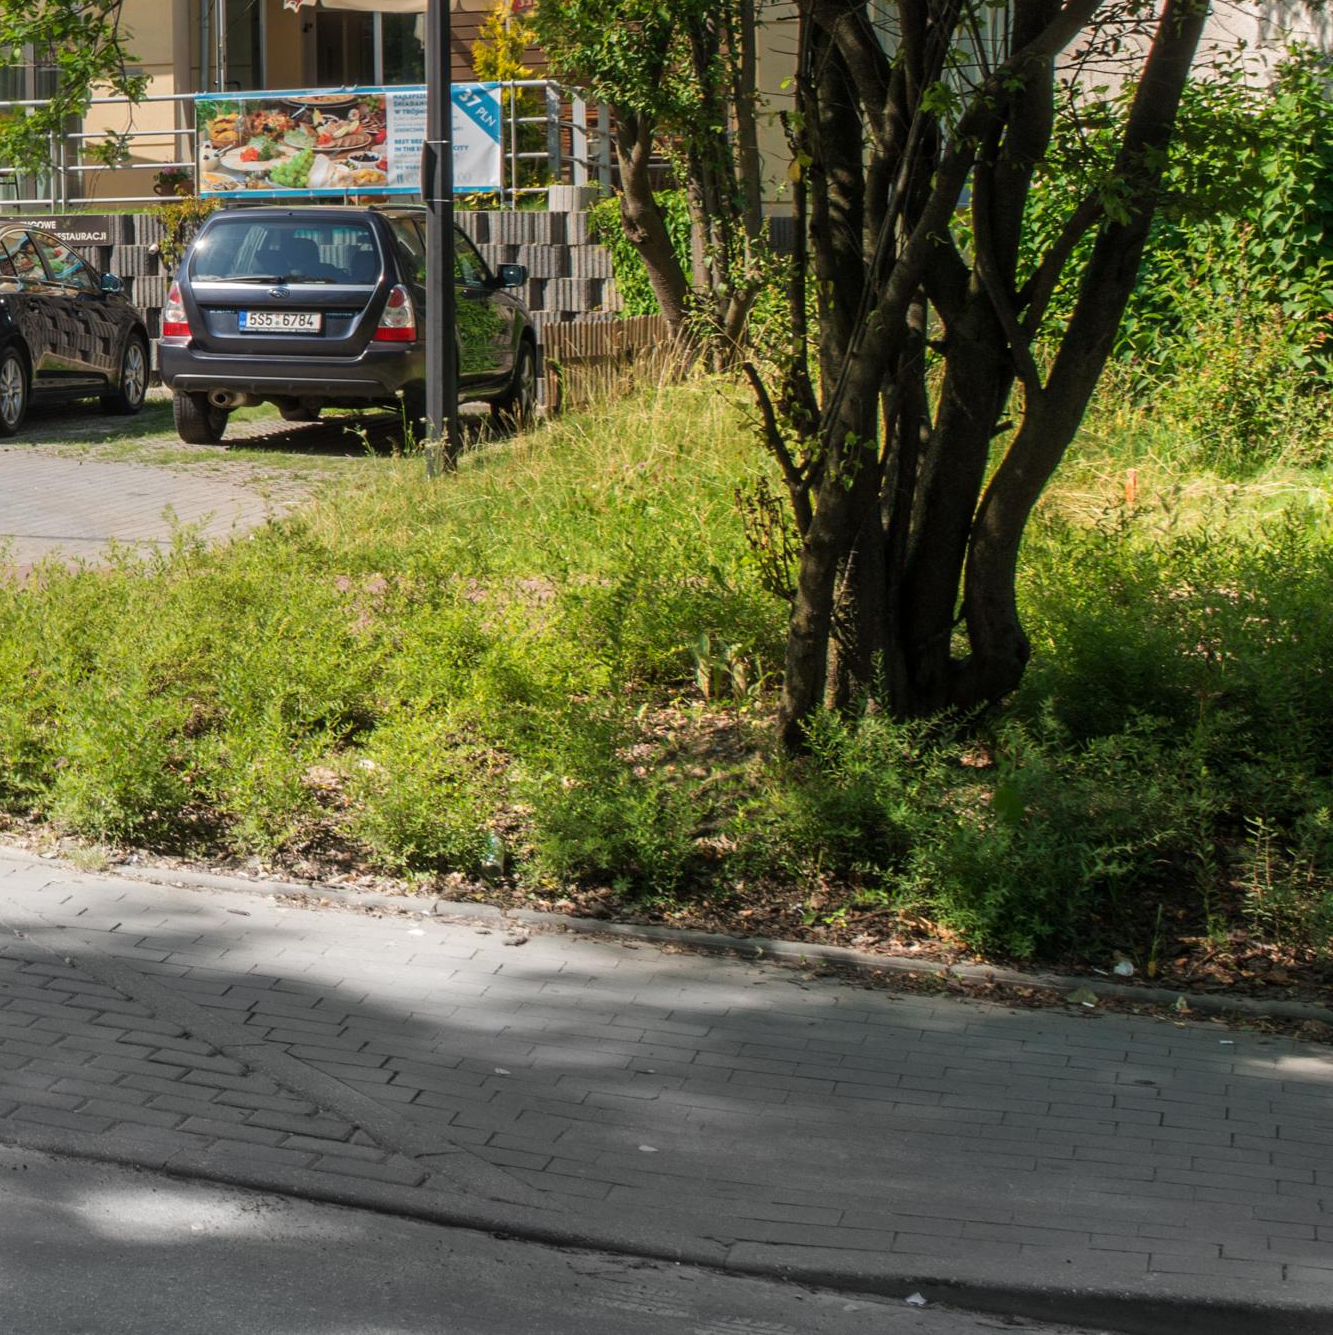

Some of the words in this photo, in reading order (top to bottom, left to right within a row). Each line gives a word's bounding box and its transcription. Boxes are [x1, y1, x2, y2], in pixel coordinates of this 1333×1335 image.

[459, 88, 483, 107] 37
[475, 106, 497, 127] PLN
[249, 313, 272, 326] 5S5
[282, 313, 314, 327] 6784
